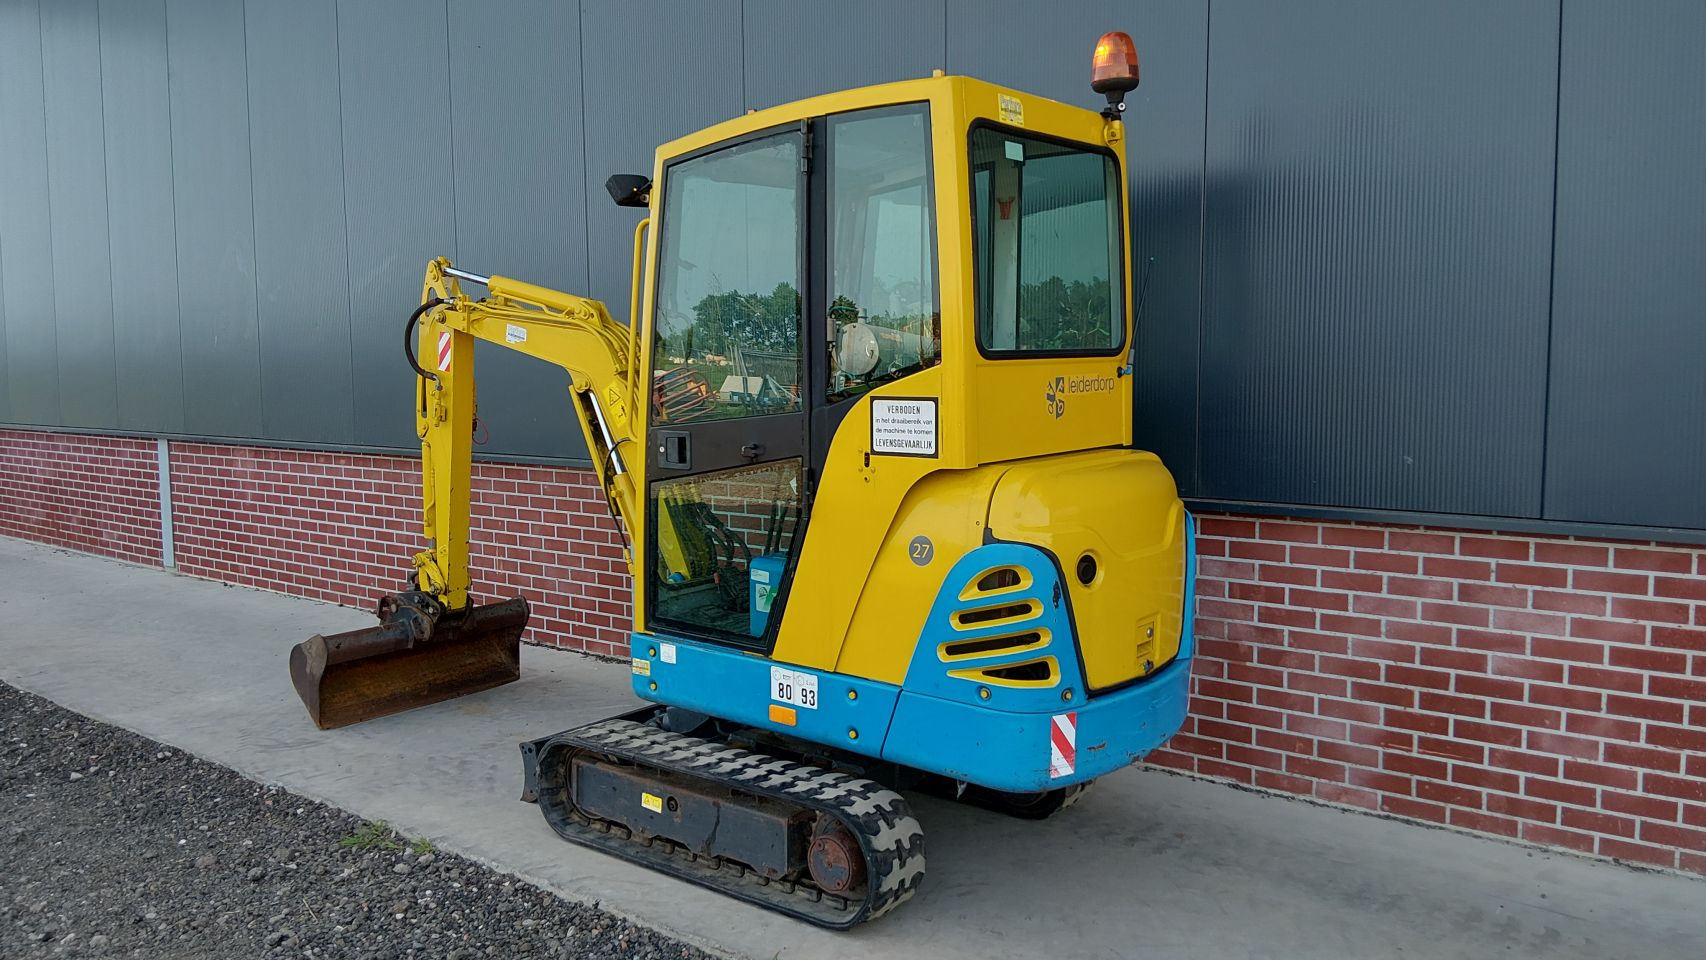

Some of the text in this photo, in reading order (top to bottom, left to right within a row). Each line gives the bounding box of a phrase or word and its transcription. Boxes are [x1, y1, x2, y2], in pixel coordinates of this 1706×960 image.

[1068, 375, 1115, 394] leiderdorp
[887, 405, 921, 415] VERBODEN
[891, 417, 922, 425] draaibereik
[875, 438, 933, 449] LEVENSGEVAARLIJK
[913, 543, 930, 558] 27
[778, 682, 792, 700] 80
[801, 688, 816, 706] 93
